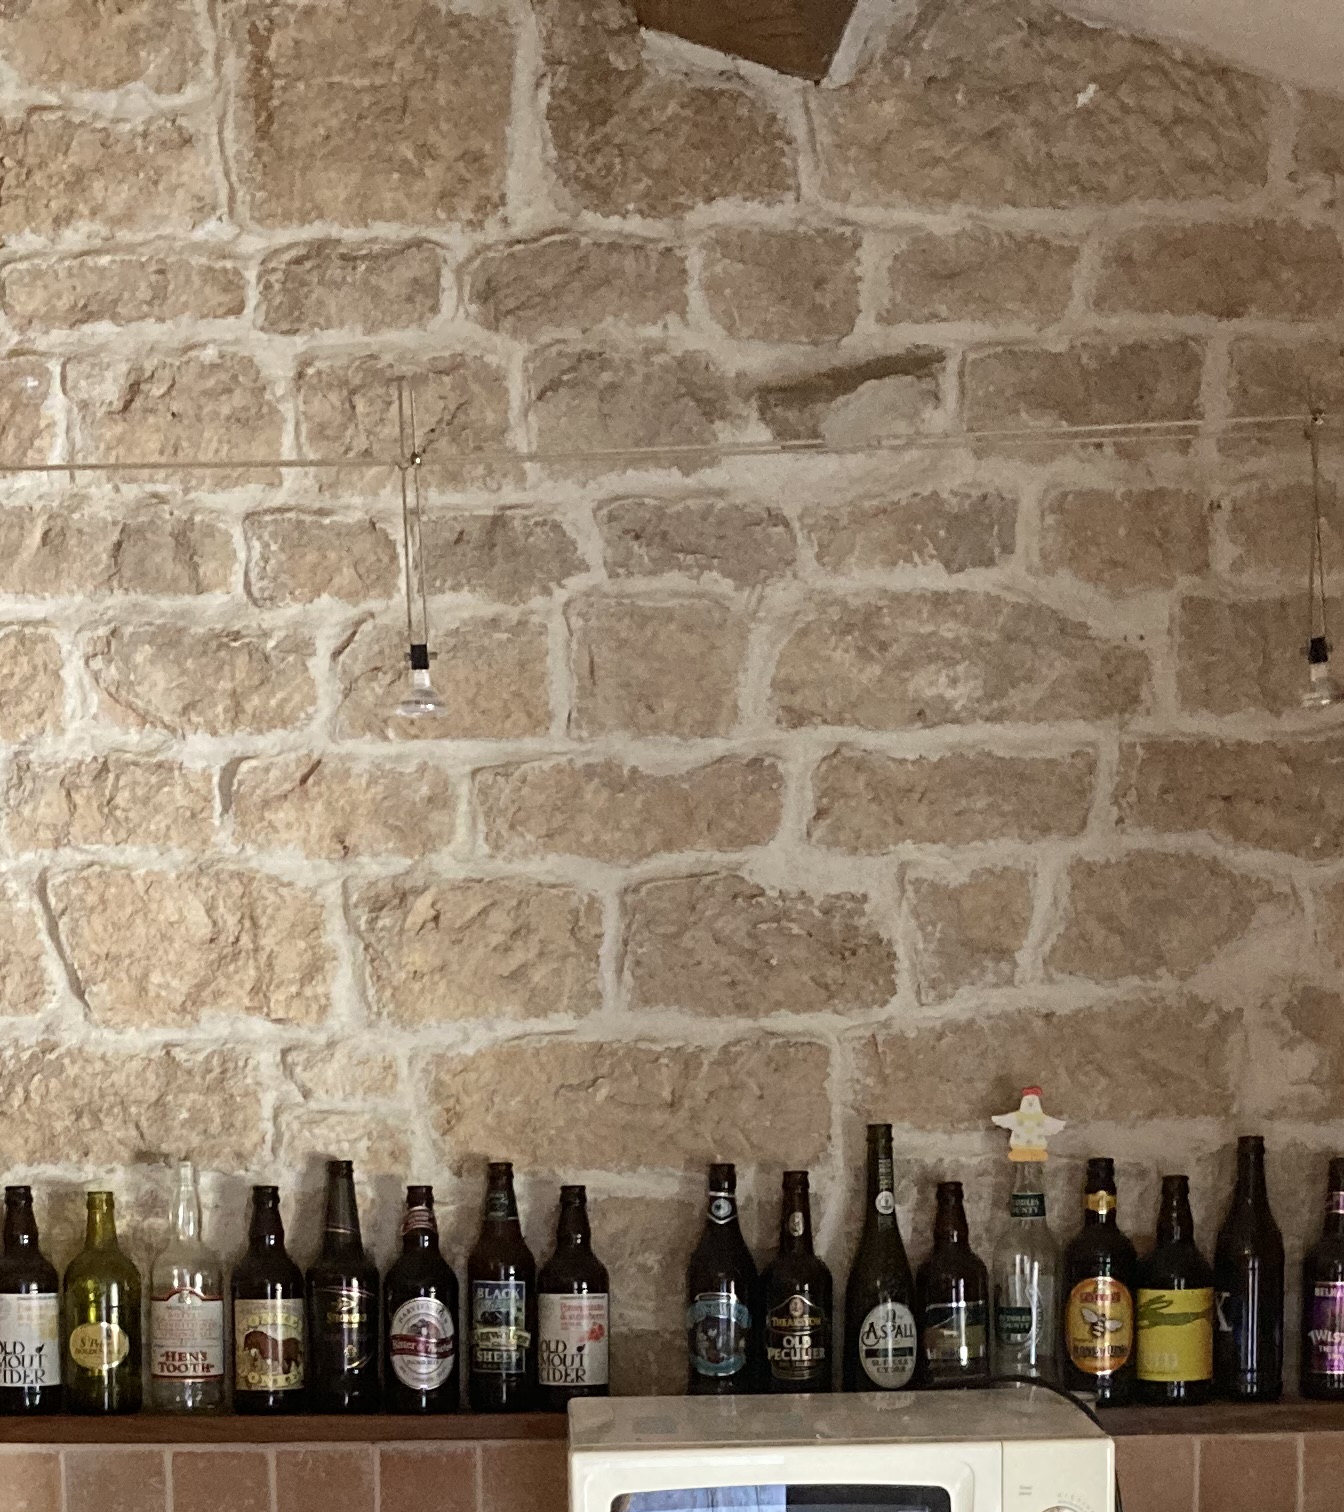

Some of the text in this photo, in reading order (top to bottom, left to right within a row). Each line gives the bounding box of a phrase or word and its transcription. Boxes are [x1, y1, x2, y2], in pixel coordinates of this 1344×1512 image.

[476, 1287, 521, 1299] BLACK
[783, 1335, 812, 1348] OLD
[476, 1351, 520, 1363] SHEEP
[767, 1347, 825, 1360] PECULIER
